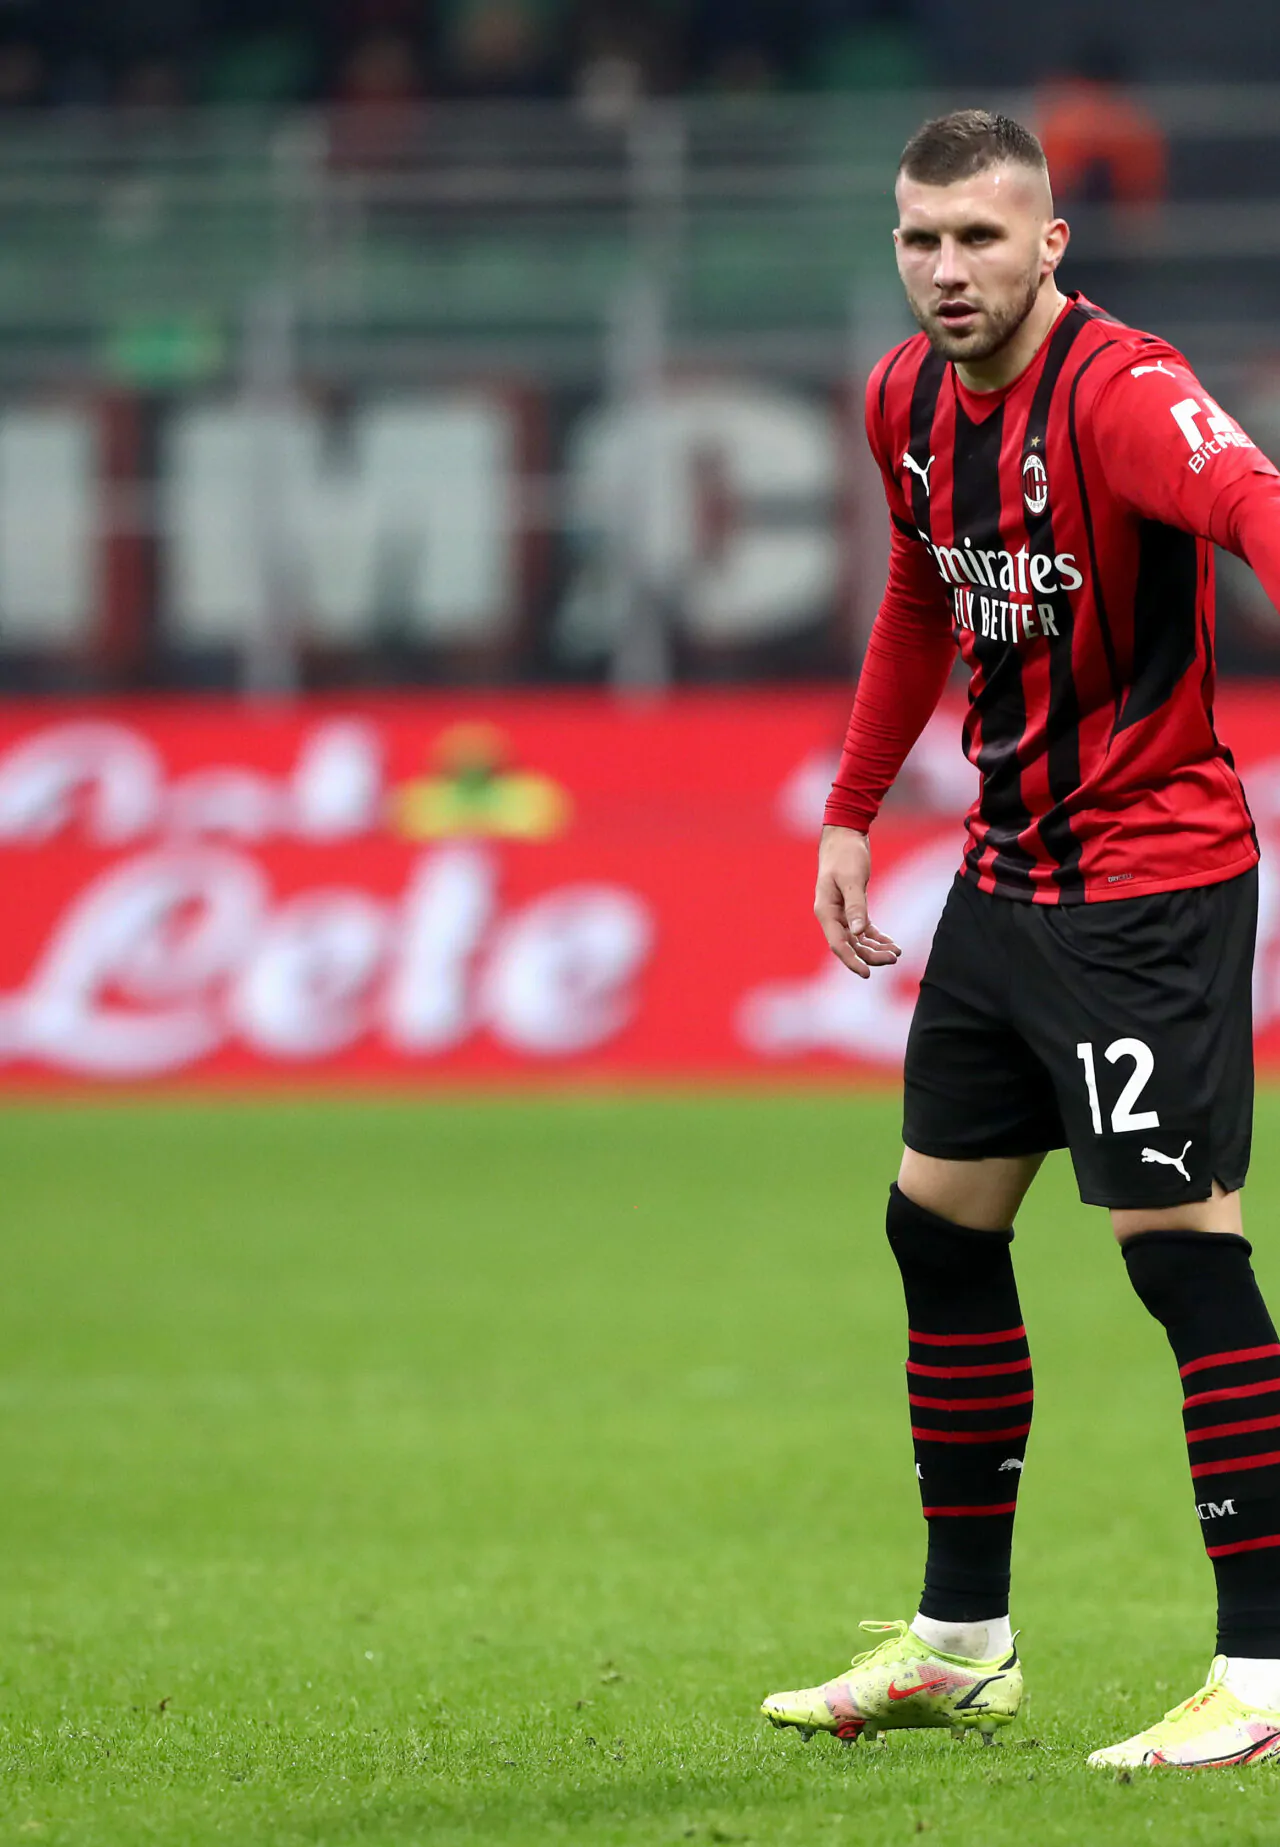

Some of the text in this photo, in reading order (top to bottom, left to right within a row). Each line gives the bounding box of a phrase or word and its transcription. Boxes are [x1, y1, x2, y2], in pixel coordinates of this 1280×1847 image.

[953, 587, 1060, 643] FLY BETTER
[1076, 1037, 1160, 1135] 12
[1195, 1498, 1238, 1520] CM
